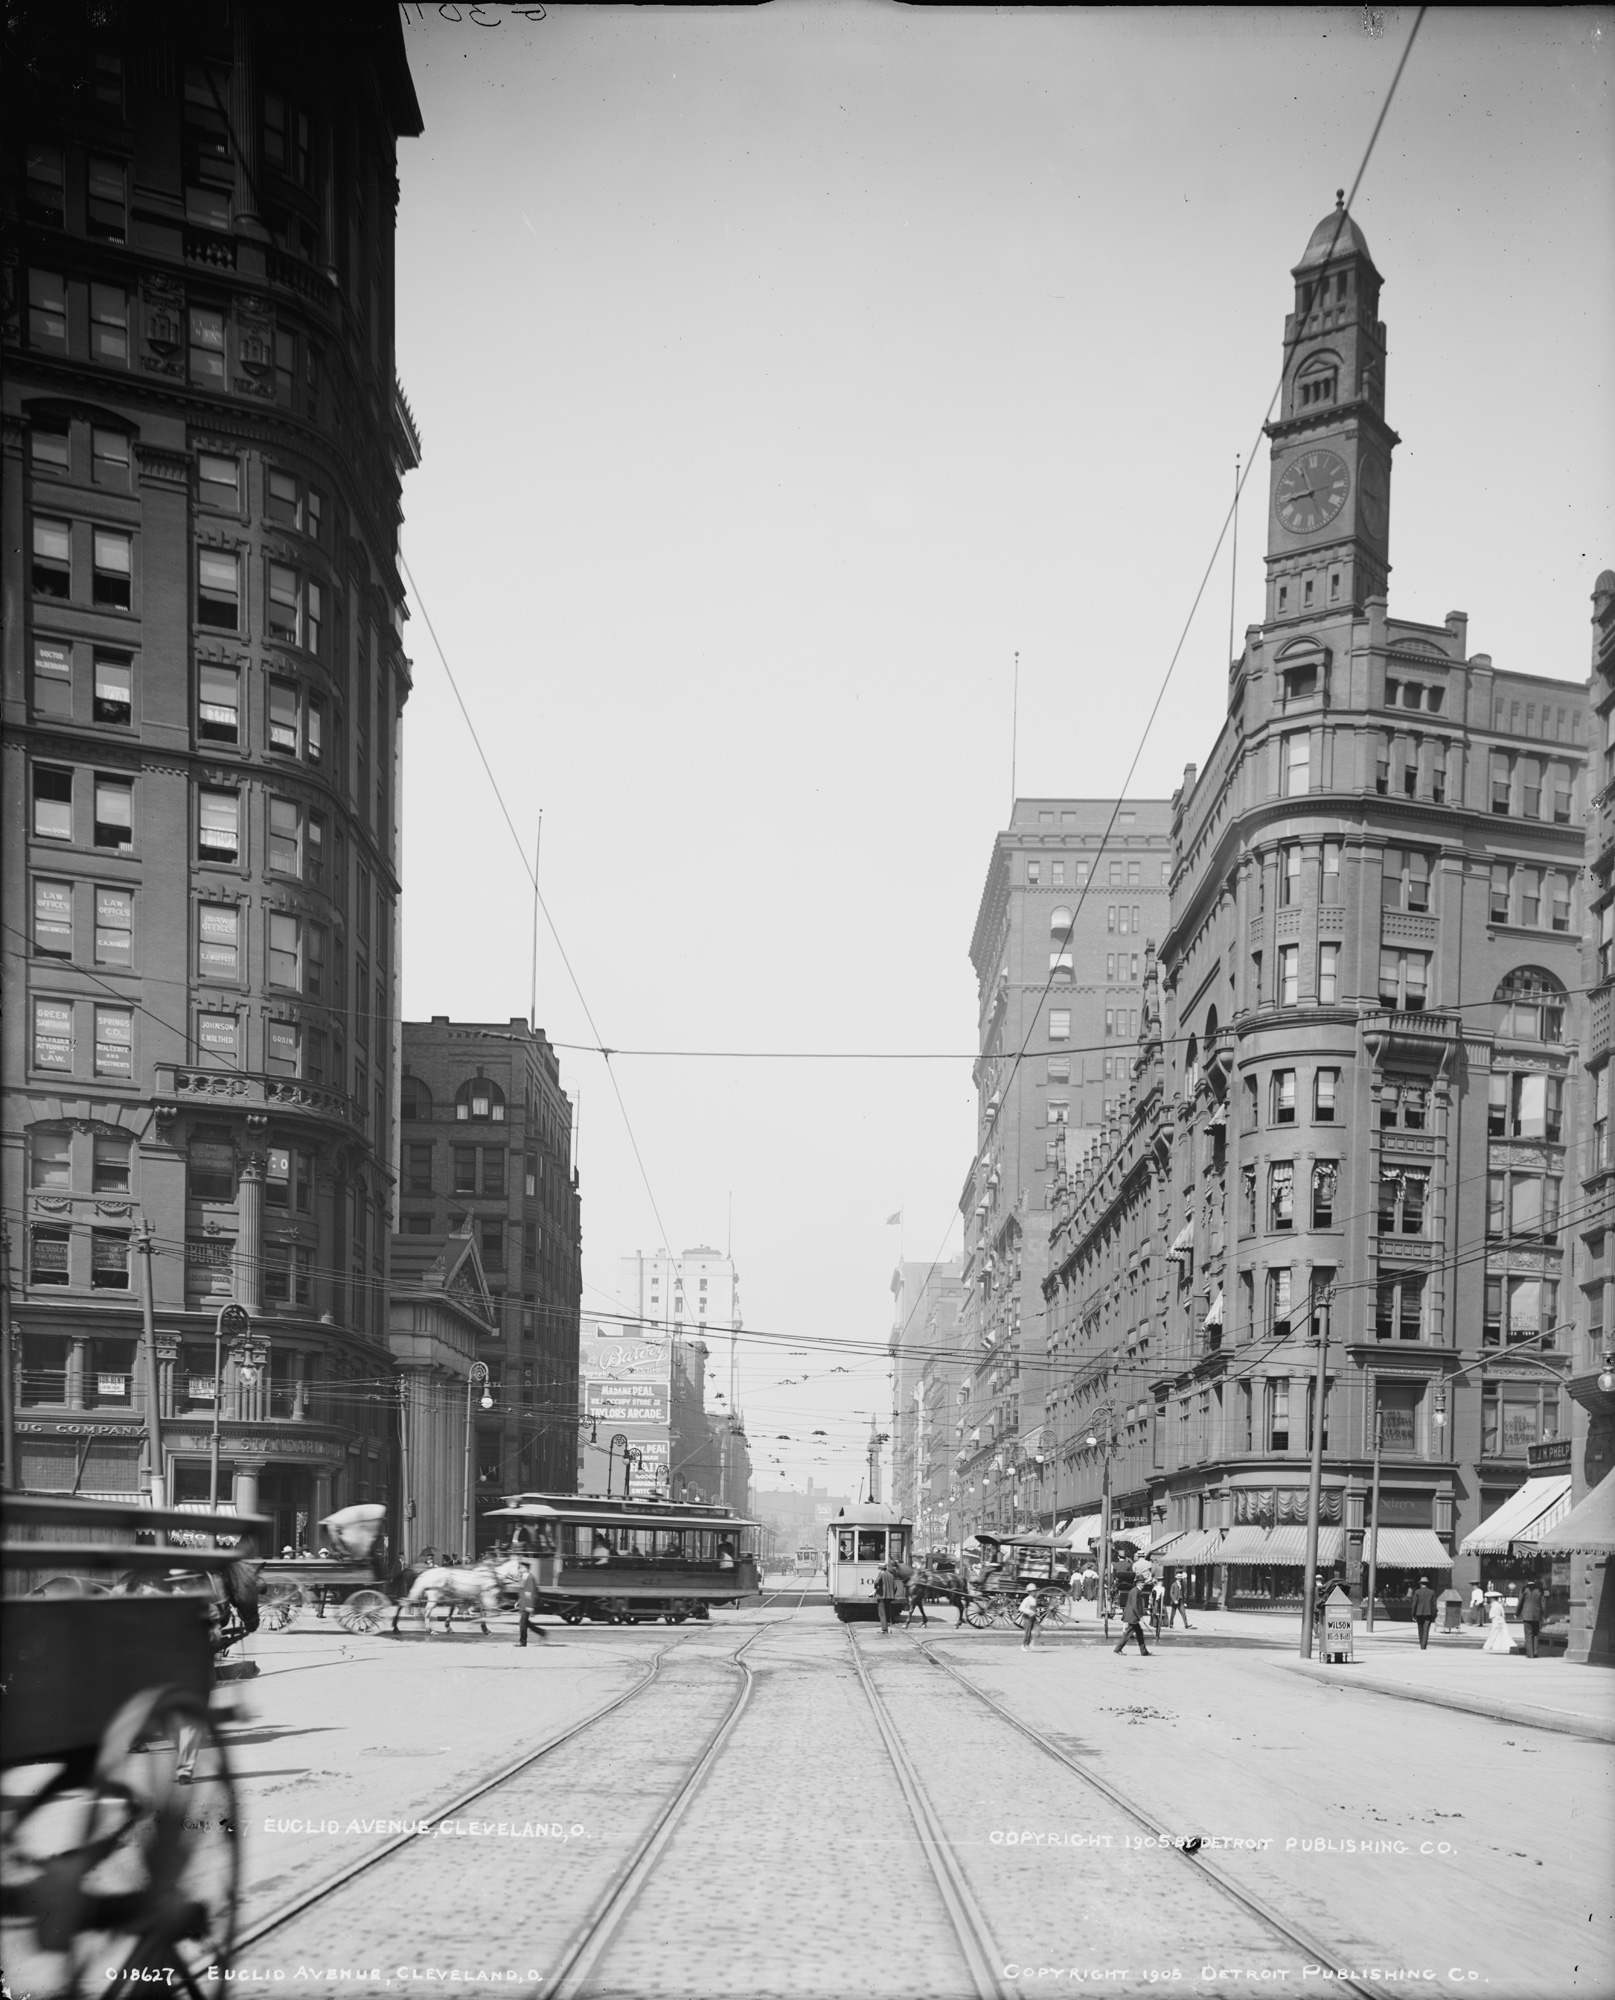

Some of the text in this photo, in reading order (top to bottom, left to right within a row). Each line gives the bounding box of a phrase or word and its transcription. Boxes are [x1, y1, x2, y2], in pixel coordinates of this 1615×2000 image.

[40, 649, 64, 661] DOCTOR
[43, 891, 63, 901] LAW
[37, 900, 70, 910] OFFICES
[103, 898, 124, 908] LAW
[99, 907, 131, 917] OFFICES
[205, 916, 229, 926] LAW
[201, 923, 236, 934] OFFICES
[37, 1009, 68, 1021] GREEN
[97, 1017, 130, 1028] SPRINGS
[201, 1021, 234, 1032] JOHNSON
[206, 1034, 234, 1045] WALTHER
[272, 1035, 294, 1046] GRAIN
[36, 1043, 70, 1052] ATTORNEY
[97, 1044, 109, 1052] REAL
[189, 1243, 232, 1266] BONDS
[601, 1385, 655, 1397] MADAME PEAL
[632, 1398, 652, 1406] STORE
[590, 1406, 665, 1420] TAYLOR'S ARCADE.
[18, 1424, 148, 1436] UG COMPANY.
[192, 1437, 227, 1450] THE
[240, 1437, 321, 1455] STANDARD
[646, 1444, 668, 1454] PEAL
[1549, 1444, 1570, 1458] PHELP
[1327, 1621, 1351, 1630] WILSON
